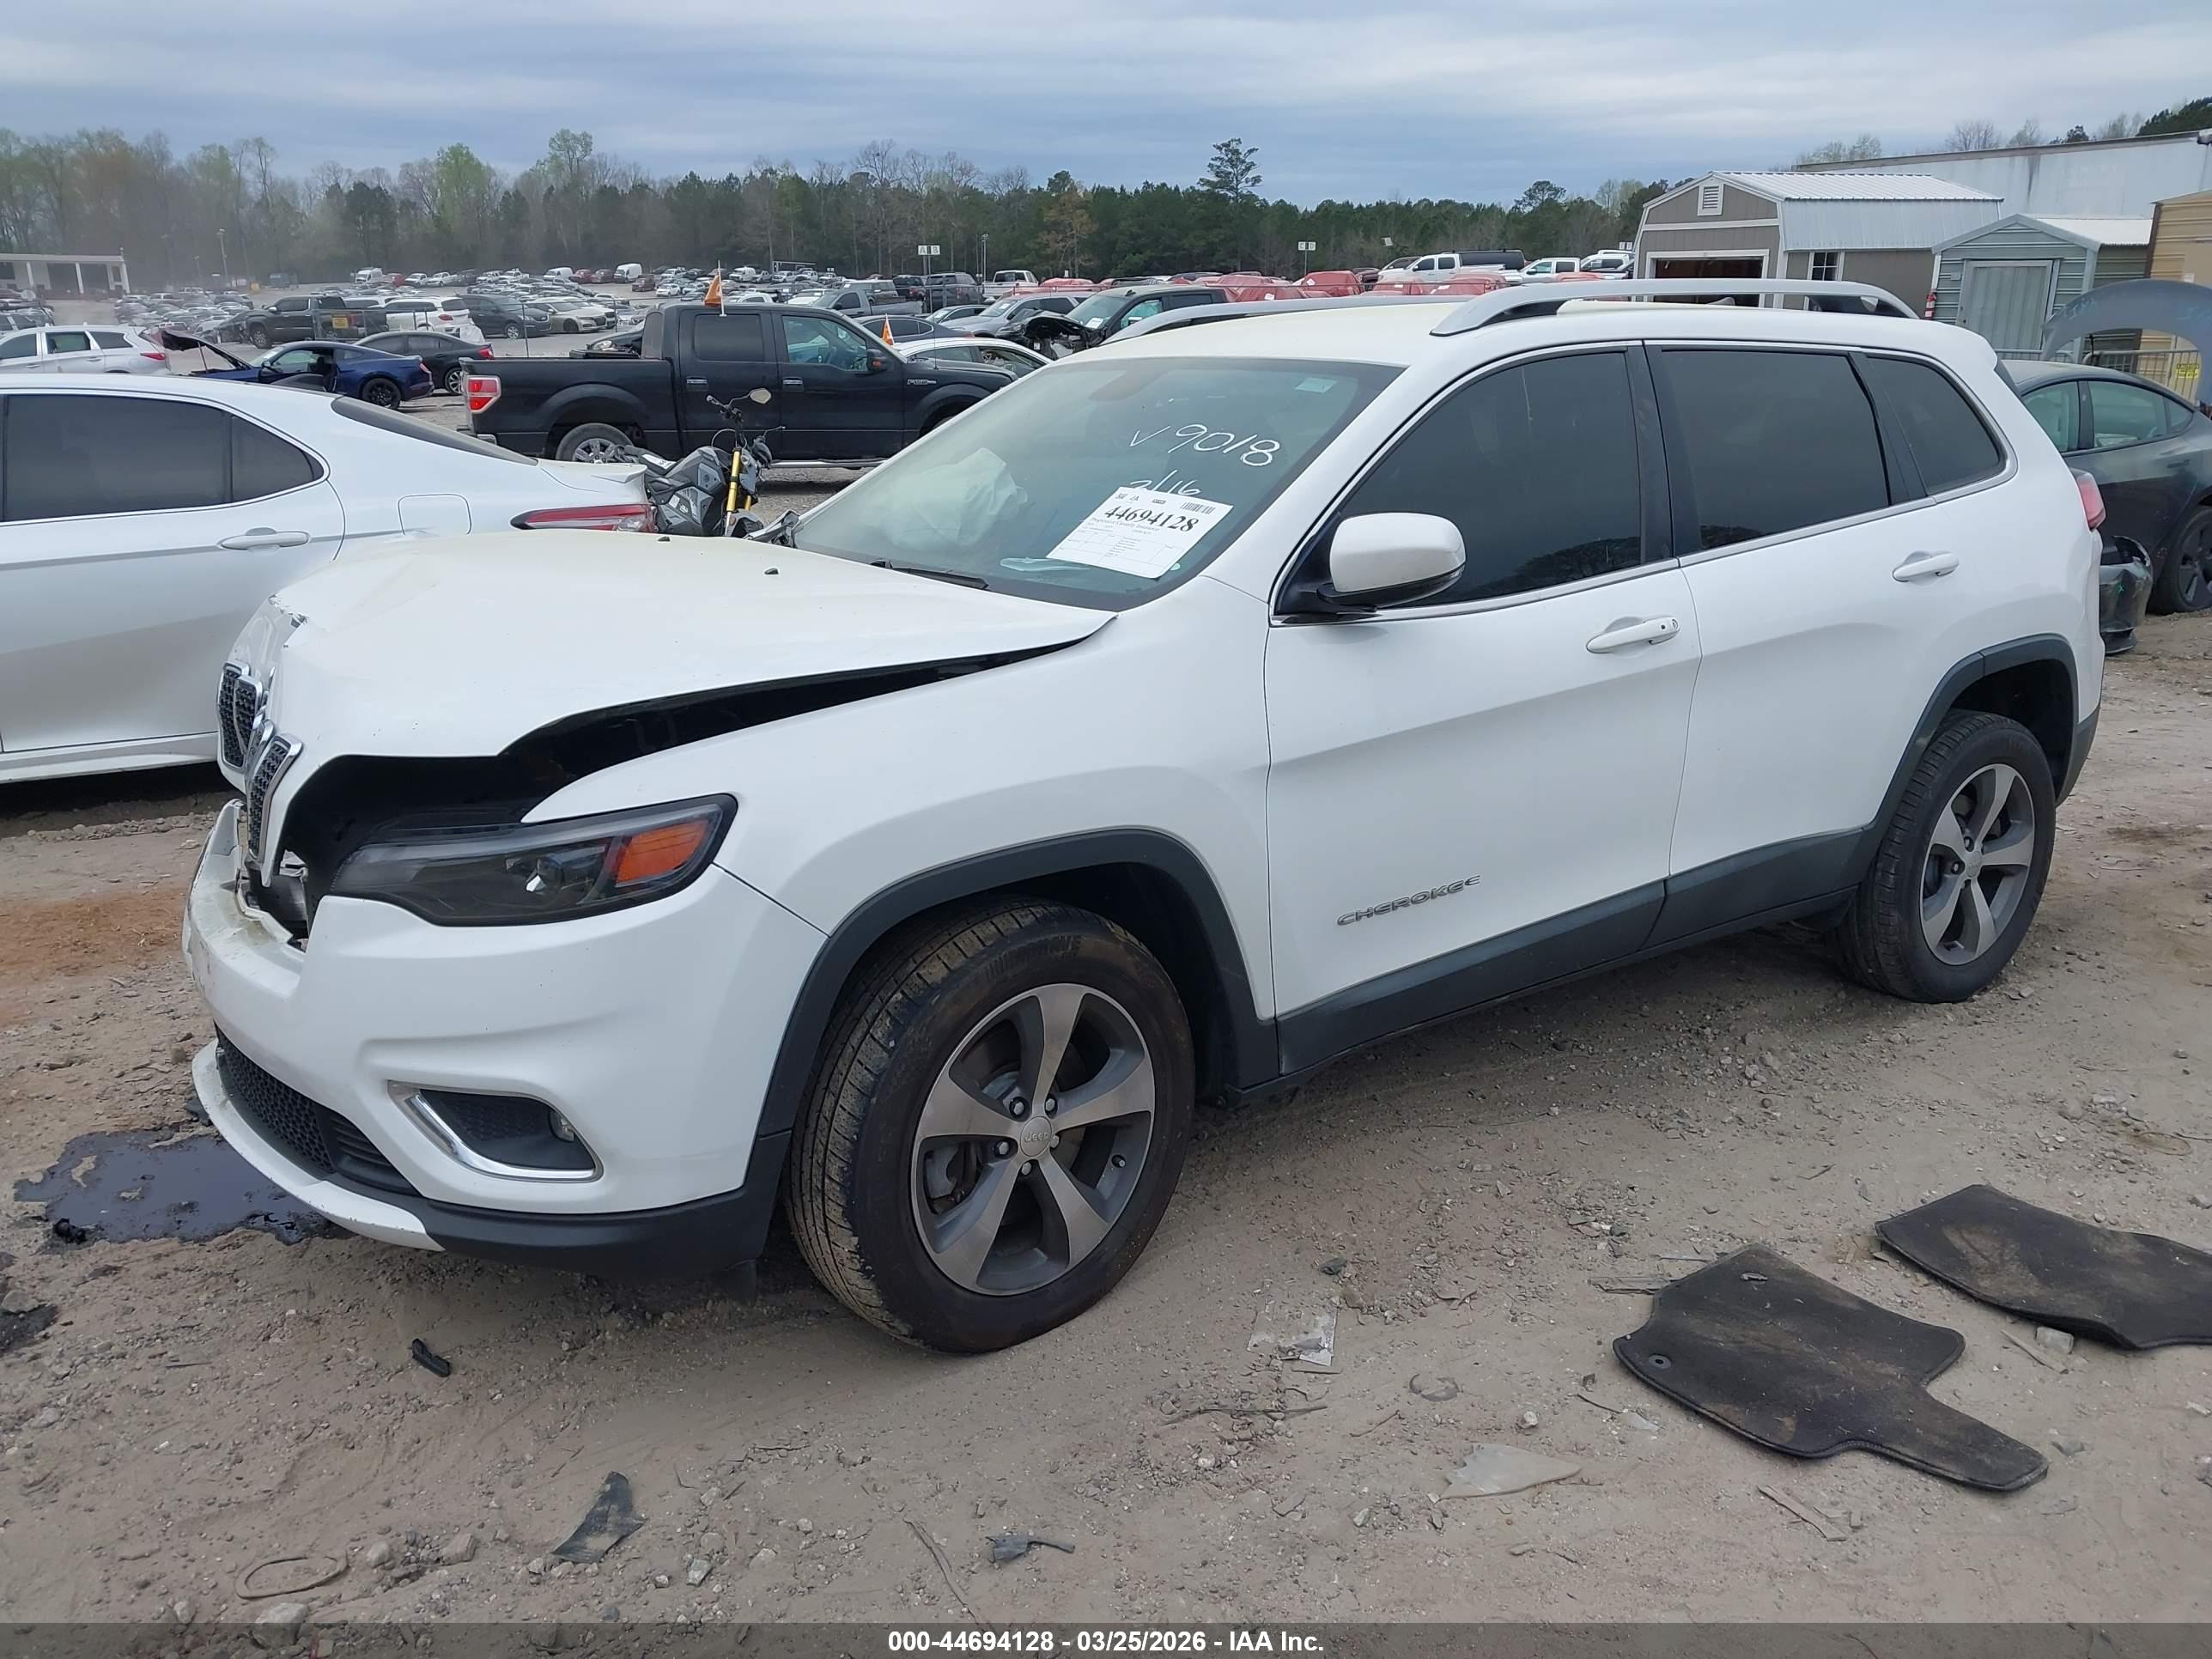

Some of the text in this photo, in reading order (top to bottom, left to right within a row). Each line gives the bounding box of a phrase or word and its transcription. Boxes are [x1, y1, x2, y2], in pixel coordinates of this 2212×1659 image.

[1168, 424, 1280, 466] 9018
[1104, 505, 1200, 532] 44694128
[1337, 874, 1480, 926] CHEROKEE
[1024, 1132, 1048, 1142] Jeep
